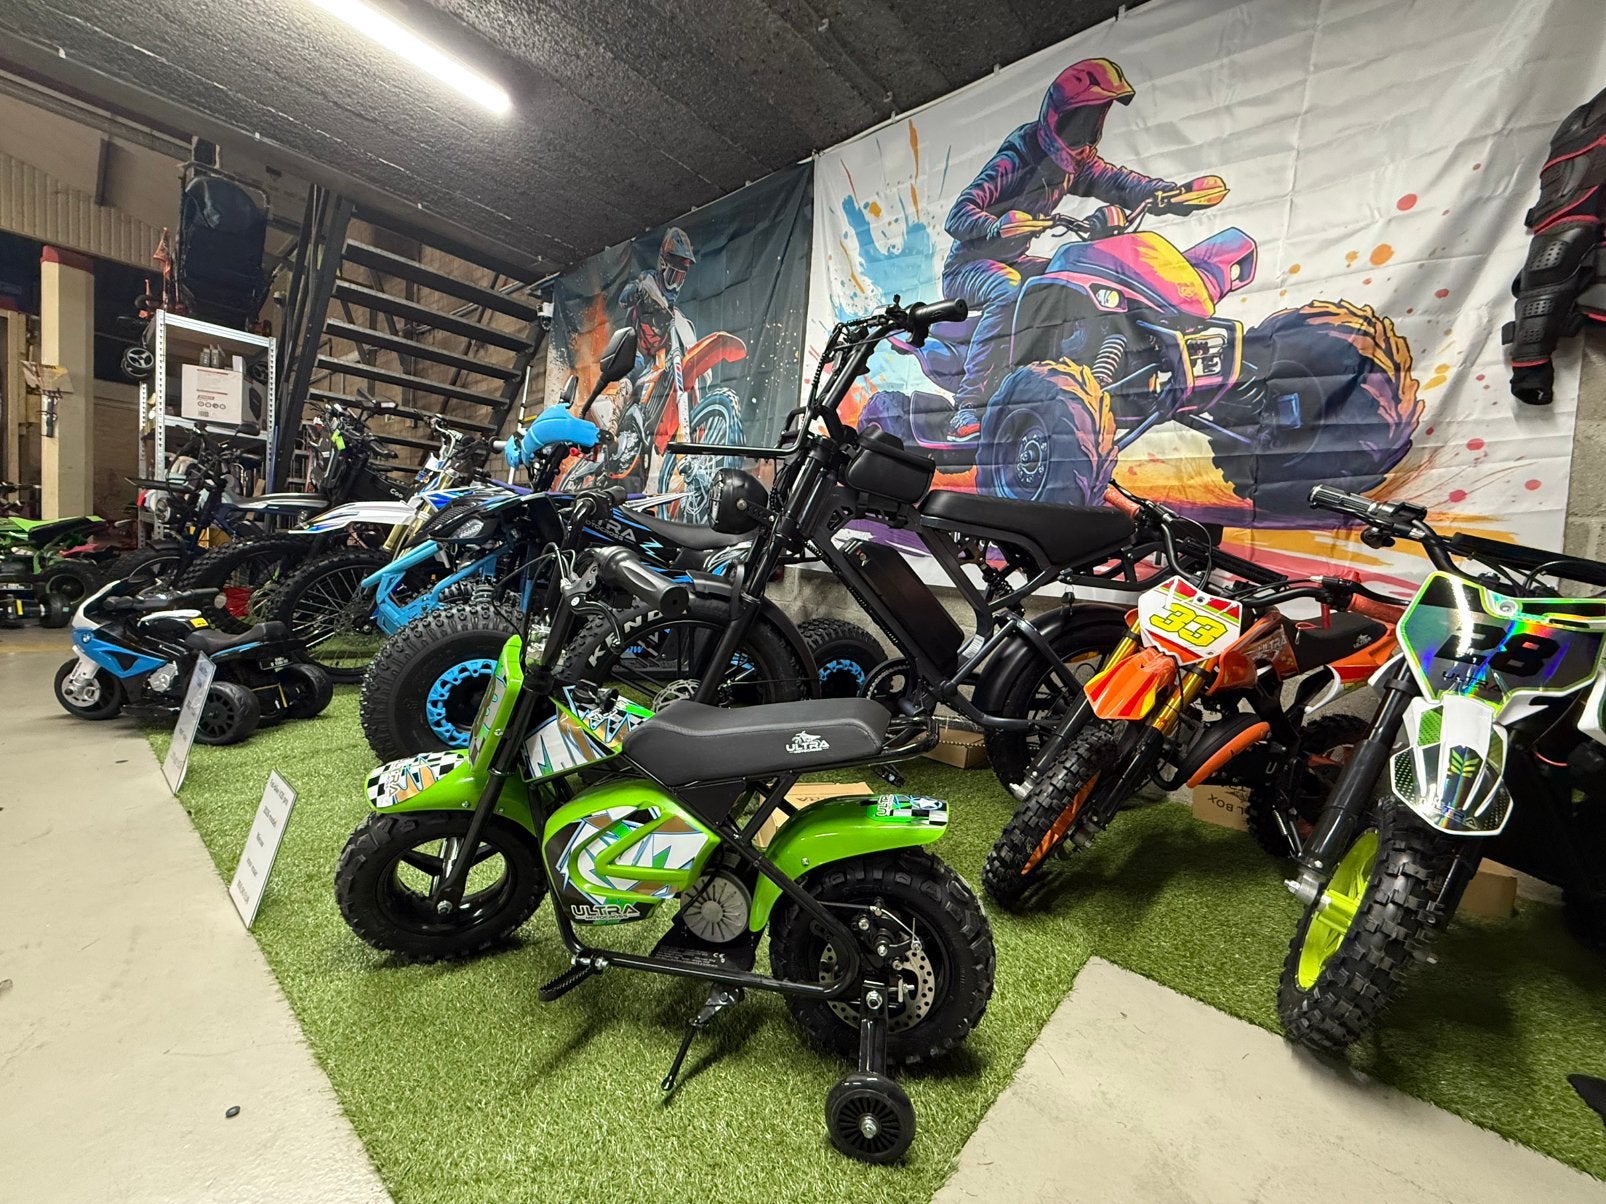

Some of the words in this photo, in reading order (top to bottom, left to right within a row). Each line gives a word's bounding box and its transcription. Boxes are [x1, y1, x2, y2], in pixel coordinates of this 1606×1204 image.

[390, 488, 404, 499] Coo
[584, 520, 625, 541] OTOCROSS
[1149, 603, 1228, 647] 33
[587, 607, 688, 668] KEND
[1434, 622, 1560, 678] 28
[785, 739, 830, 753] ULTRA
[1207, 792, 1234, 812] BOX
[570, 903, 641, 916] ULTRA
